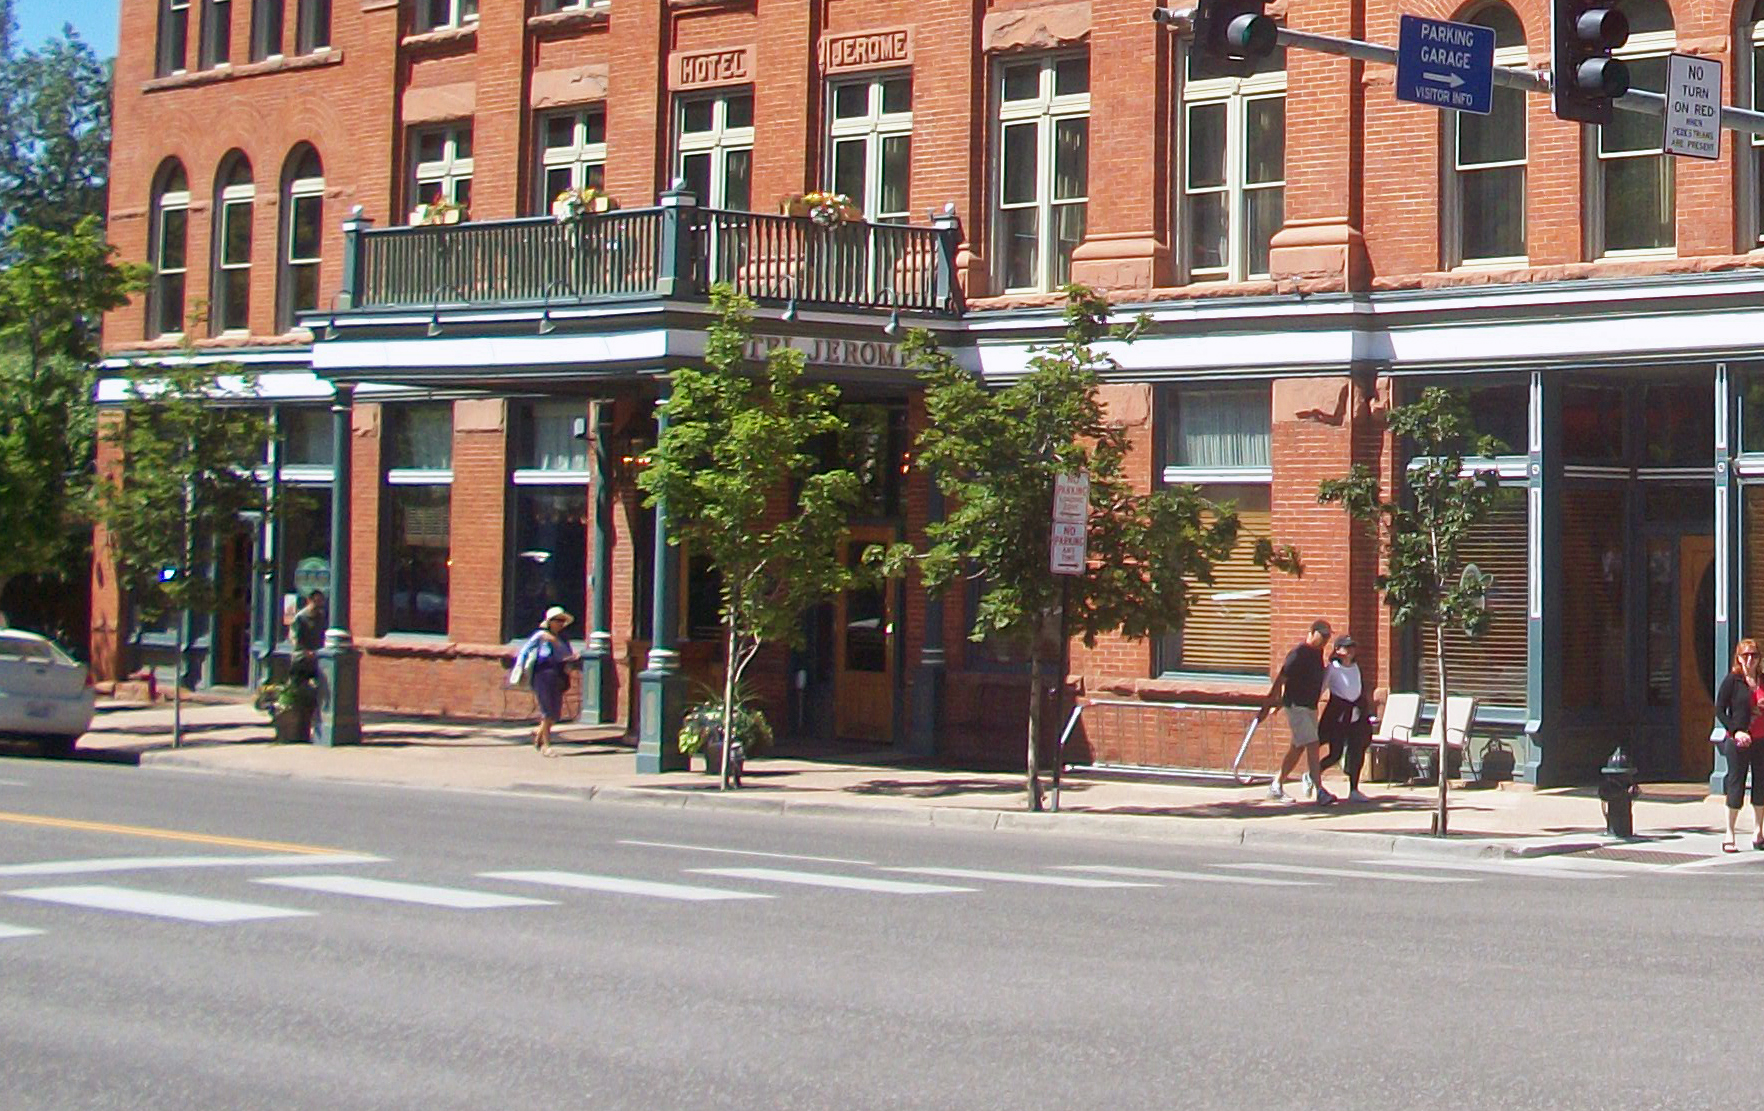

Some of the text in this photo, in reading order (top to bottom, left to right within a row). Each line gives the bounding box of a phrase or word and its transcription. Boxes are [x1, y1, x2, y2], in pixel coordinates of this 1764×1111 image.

[1421, 23, 1474, 47] PARKING
[832, 33, 907, 66] JEROME
[1421, 46, 1471, 69] GARAGE
[681, 52, 746, 85] HOTEL
[1688, 64, 1704, 81] NO
[1415, 85, 1473, 106] VISITOR INFO
[1682, 85, 1709, 100] TURN
[1674, 101, 1714, 118] ON RED
[1672, 127, 1714, 140] PEDESTRIANS
[1671, 138, 1714, 152] ARE PRESENT
[1063, 526, 1076, 536] NO
[1053, 536, 1084, 545] PARKING
